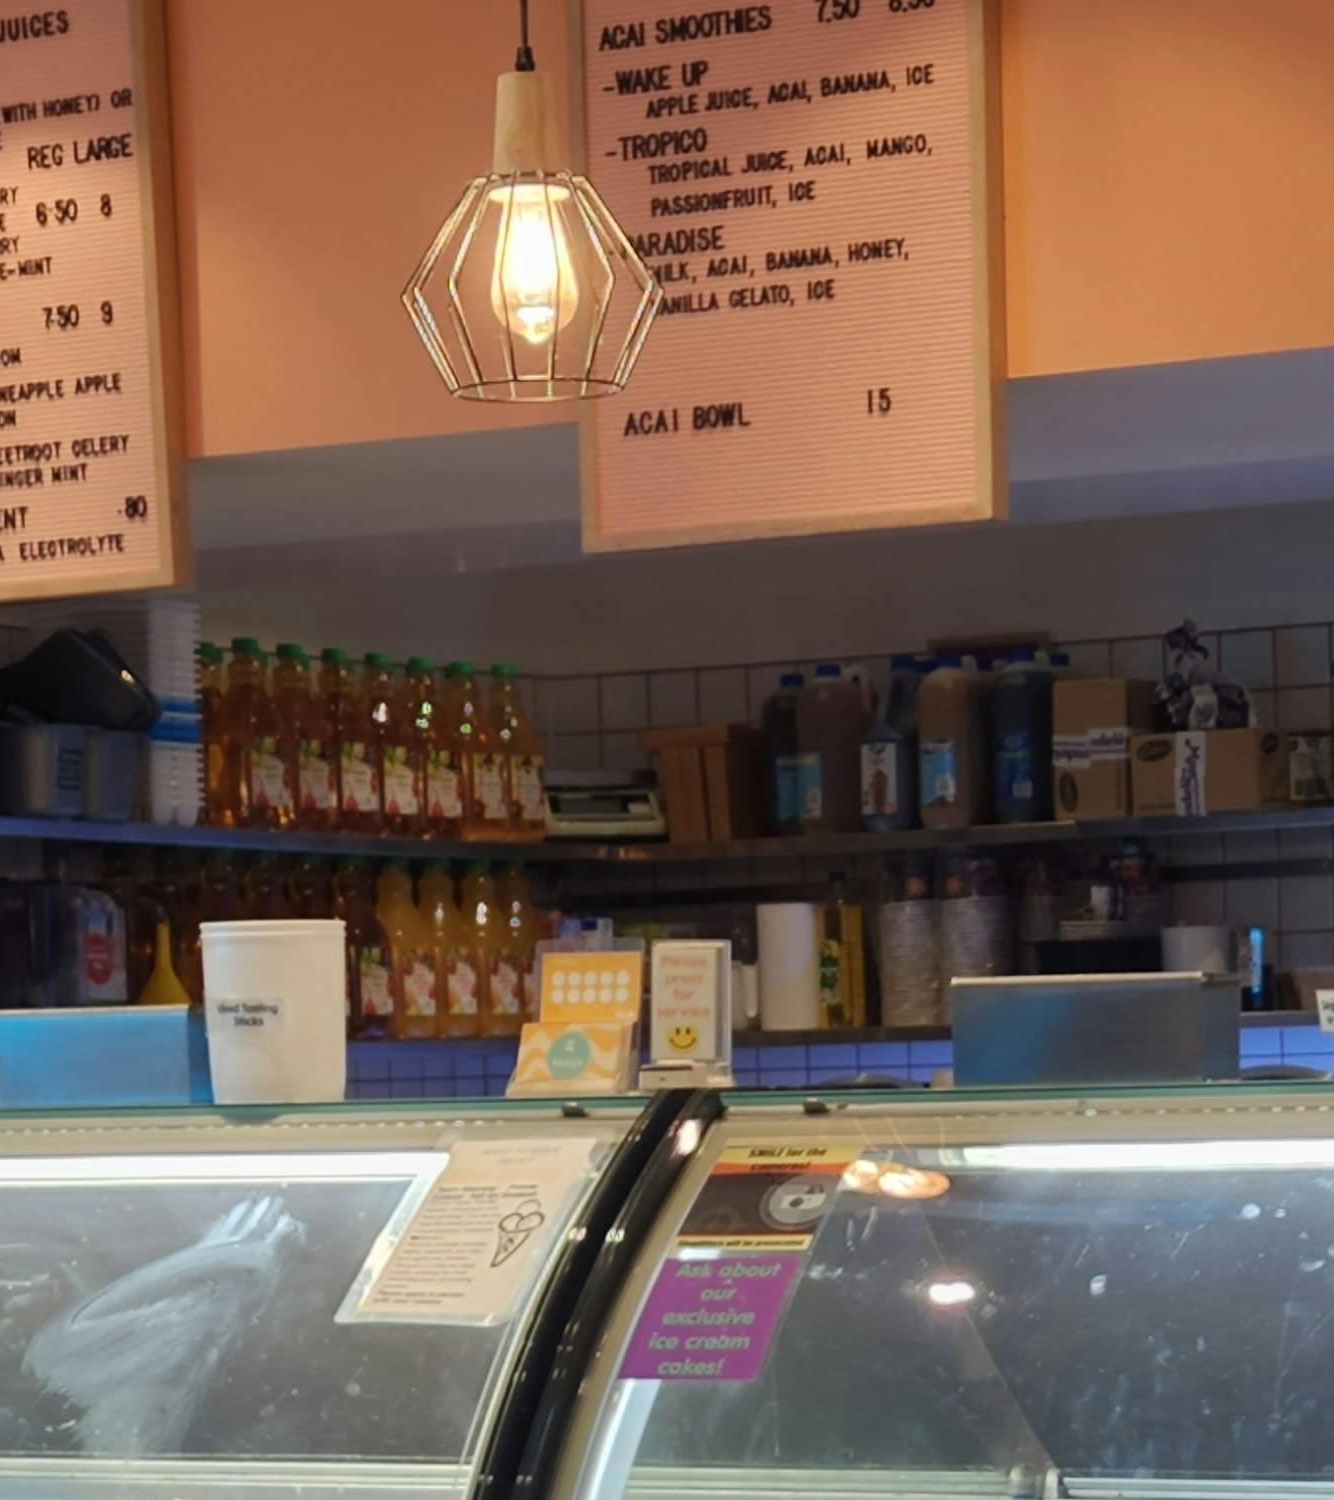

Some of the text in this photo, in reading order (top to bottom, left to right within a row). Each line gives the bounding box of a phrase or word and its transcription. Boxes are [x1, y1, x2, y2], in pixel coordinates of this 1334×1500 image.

[599, 5, 772, 52] ACAI SMOOTHIES
[682, 60, 708, 87] UP
[43, 93, 101, 119] HONEY)
[110, 89, 133, 109] OR
[646, 64, 935, 119] APPLE JUICE, ACAI, BANANA, ICE
[27, 133, 134, 171] REG LARGE
[648, 157, 731, 185] TROPICAL
[804, 143, 851, 166] ACAI,
[867, 133, 933, 158] MANGO,
[100, 194, 113, 218] 8
[650, 180, 816, 218] PASSIONFRUIT, ICE
[707, 237, 910, 279] ACAI, BANANA, HONEY,
[729, 278, 836, 308] GELATO, ICE
[101, 301, 114, 326] 9
[74, 372, 122, 396] APPLE
[623, 387, 892, 437] ACAI BOWL 15
[71, 434, 130, 458] CELERY
[51, 463, 88, 485] MINT
[19, 533, 125, 561] ELECTROLYTE
[241, 1002, 279, 1016] Tasting
[674, 1262, 781, 1278] Ask about
[701, 1287, 736, 1302] our
[661, 1309, 755, 1326] exclusive
[647, 1333, 751, 1350] ice cream
[657, 1358, 725, 1377] cakes!
